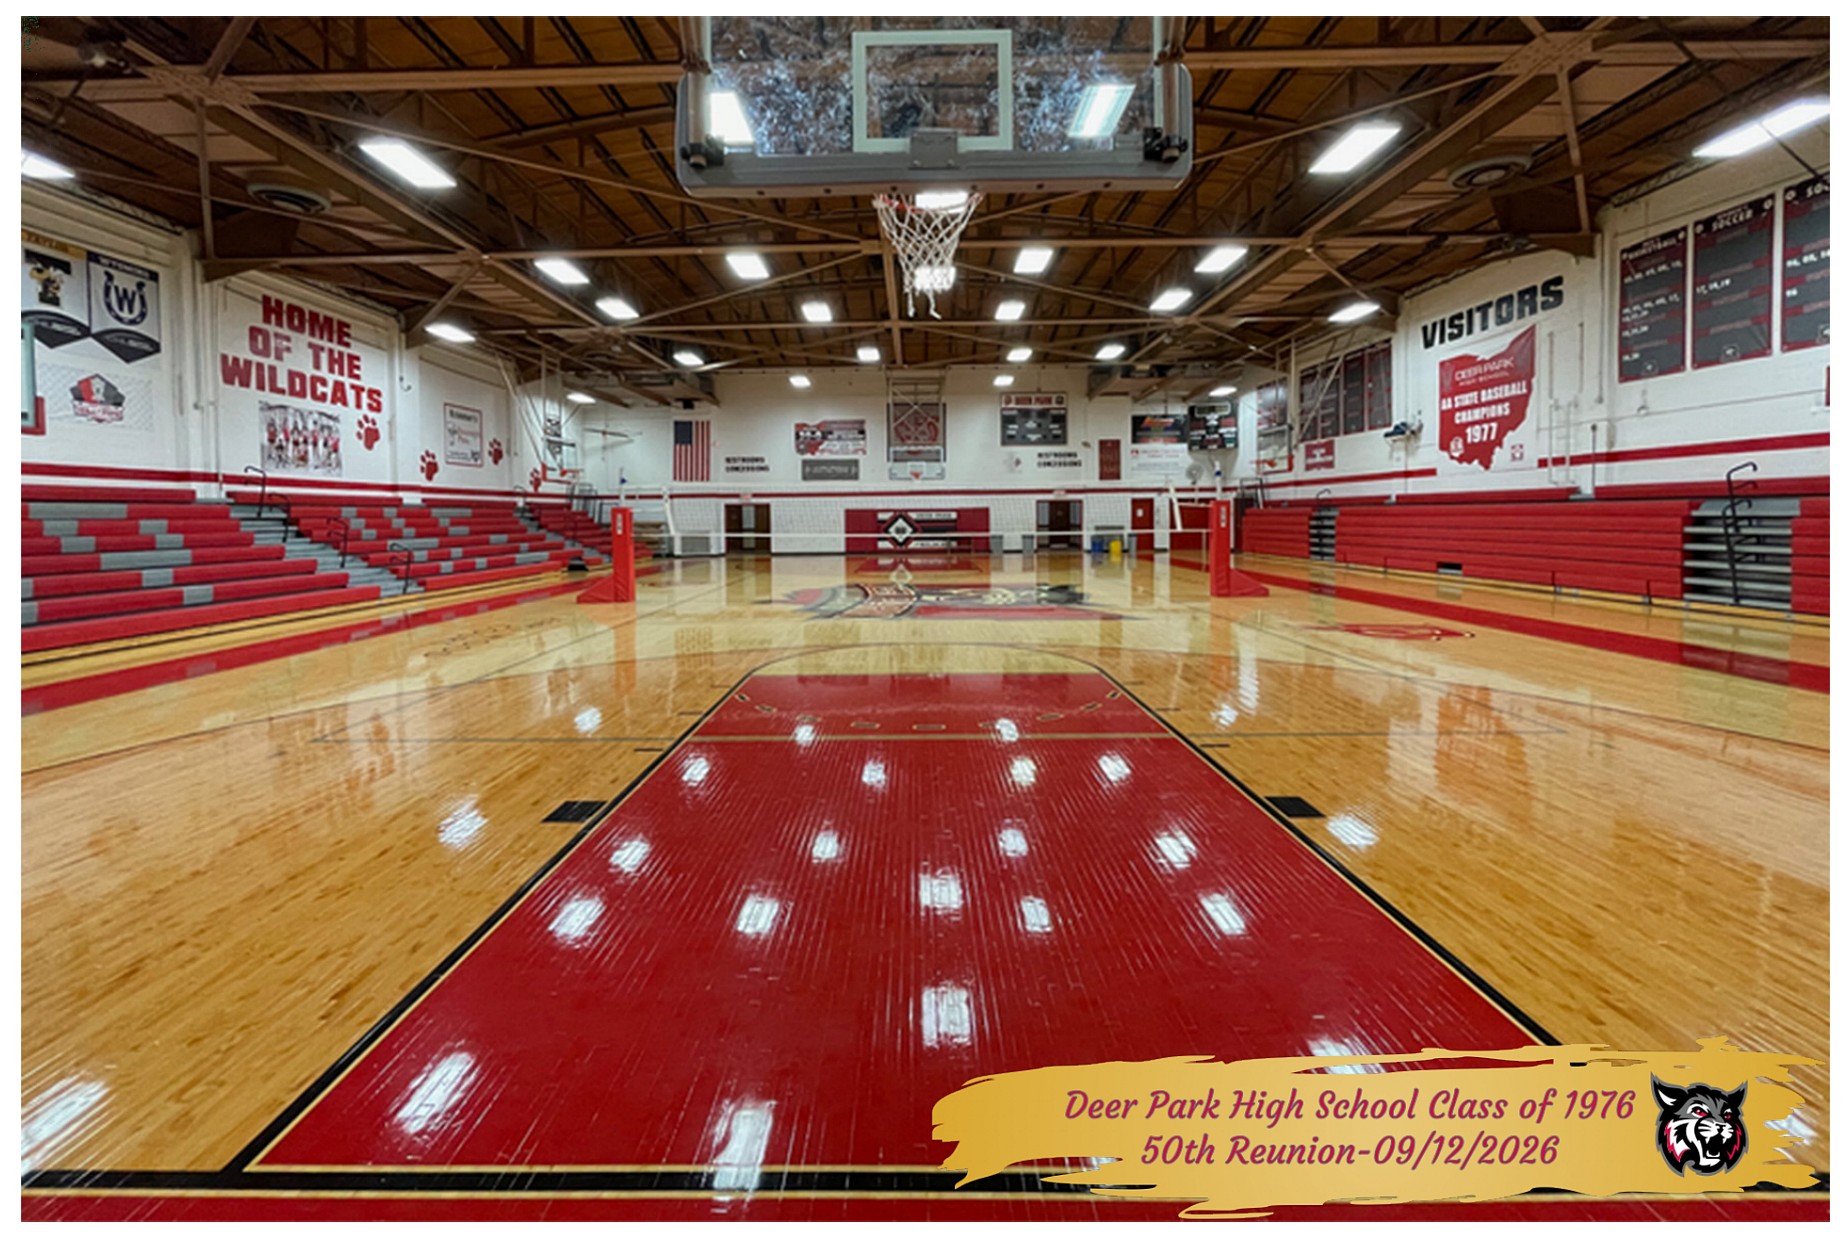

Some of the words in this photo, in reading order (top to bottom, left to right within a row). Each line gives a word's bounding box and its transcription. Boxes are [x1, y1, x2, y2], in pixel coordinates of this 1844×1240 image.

[1712, 209, 1754, 232] SOCCER
[262, 294, 352, 348] HOME
[1421, 275, 1564, 350] VISITORS
[248, 324, 292, 362] OF
[308, 341, 361, 381] THE
[220, 352, 383, 413] WILDCATS
[1454, 364, 1482, 381] DEER
[1482, 356, 1514, 373] PARK
[1441, 397, 1453, 411] AA
[1454, 391, 1479, 409] STATE
[1481, 380, 1528, 403] BASEBALL
[1454, 401, 1511, 425] CHAMPIONS
[1465, 421, 1499, 445] 1977
